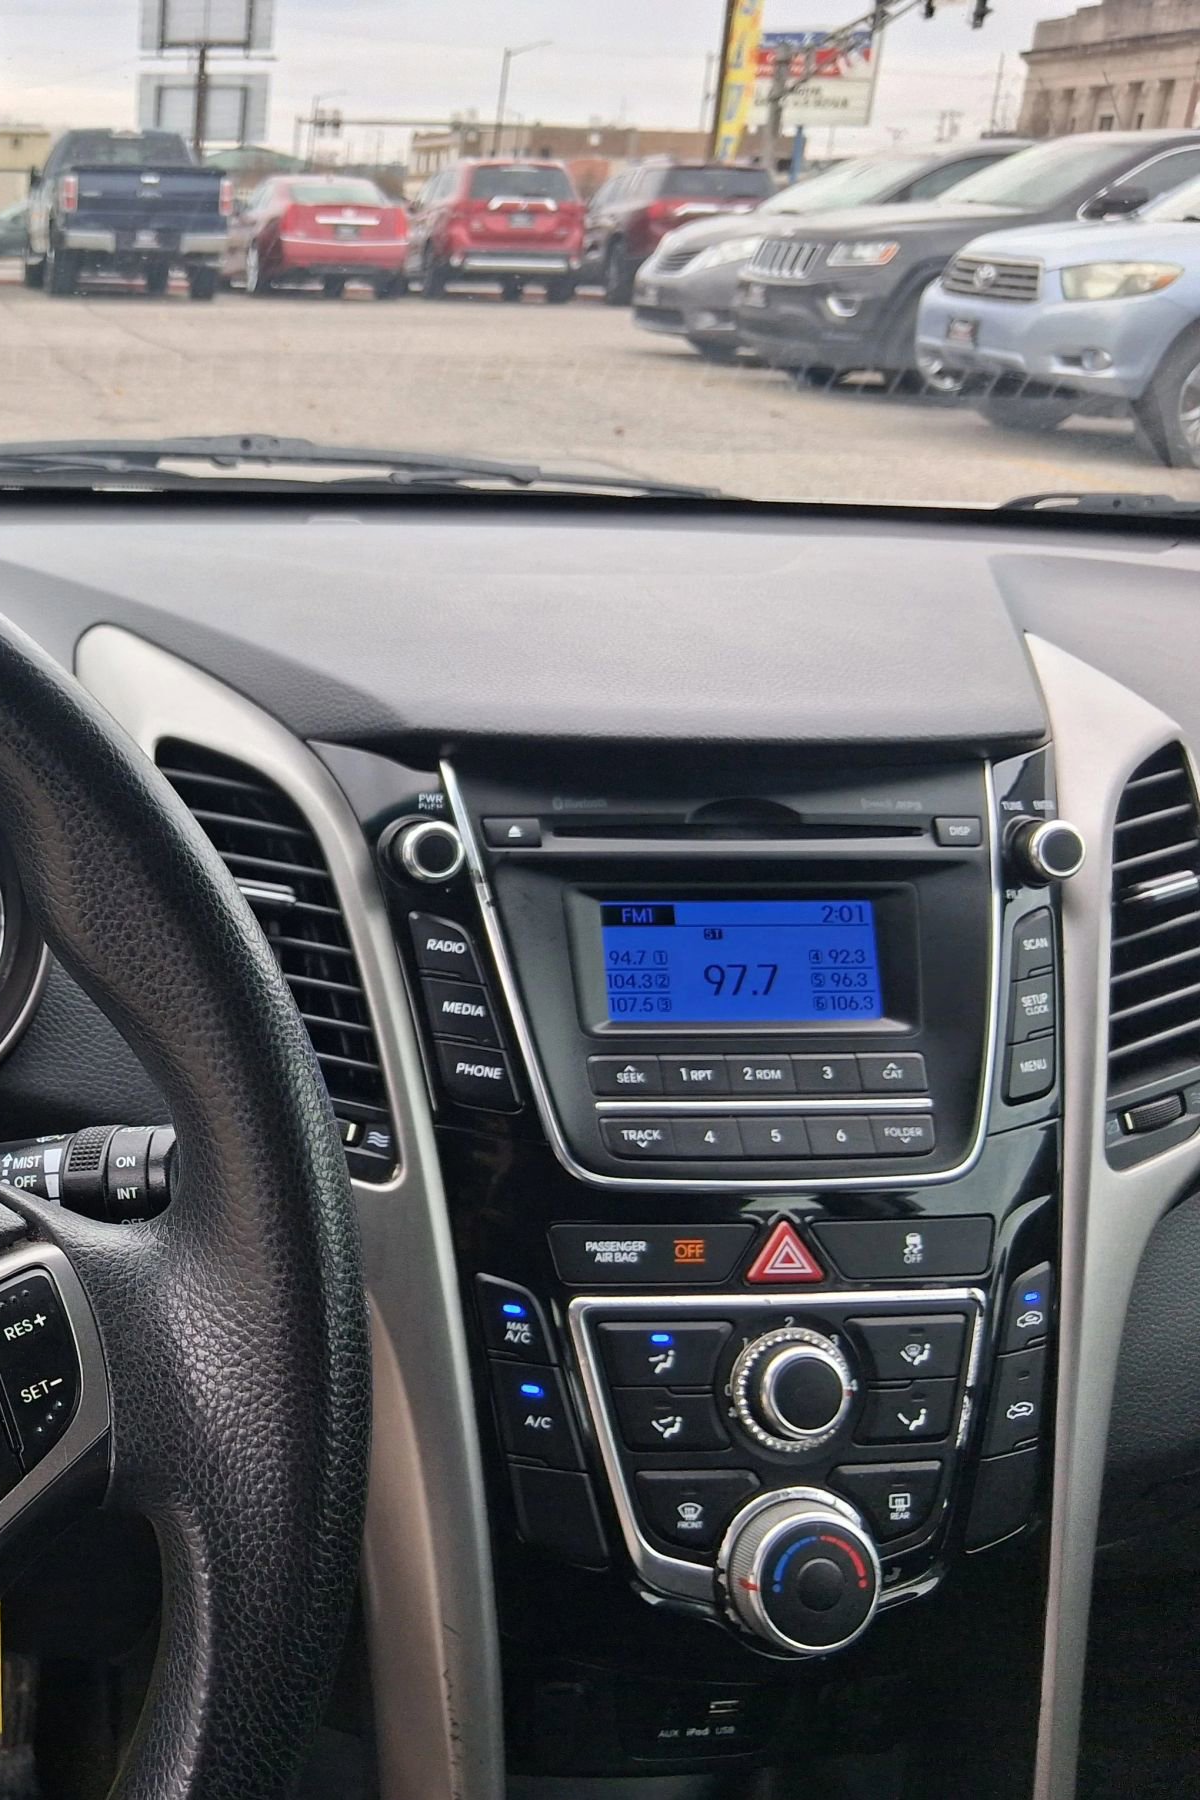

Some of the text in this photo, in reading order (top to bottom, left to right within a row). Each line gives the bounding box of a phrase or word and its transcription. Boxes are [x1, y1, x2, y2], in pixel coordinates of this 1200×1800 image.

[418, 794, 443, 804] PWR
[948, 826, 971, 837] DISP
[621, 908, 653, 923] FM1
[821, 905, 864, 923] 2:01
[704, 928, 722, 940] ST
[426, 938, 466, 955] RADIO
[1023, 938, 1048, 950] SCAN
[609, 951, 646, 965] 94.7
[828, 949, 866, 964] 92.3
[607, 974, 652, 989] 104.3
[703, 963, 778, 996] 97.7
[831, 973, 868, 988] 96.3
[610, 997, 654, 1012] 107.5
[831, 996, 874, 1011] 106.3
[1021, 993, 1048, 1007] SETUP
[442, 1001, 486, 1017] MEDIA
[1025, 1005, 1049, 1016] CLOCK
[456, 1062, 503, 1080] PHONE
[1020, 1059, 1047, 1073] MENU
[616, 1071, 645, 1084] SEEK
[680, 1068, 713, 1081] 1 RPT
[743, 1067, 782, 1081] 2 RDM
[822, 1066, 833, 1080] 3
[883, 1068, 903, 1079] CAT
[621, 1130, 662, 1141] TRACK
[704, 1130, 715, 1143] 4
[771, 1129, 782, 1143] 5
[836, 1128, 847, 1142] 6
[884, 1126, 923, 1138] FOLDER
[12, 1155, 42, 1169] MIST
[116, 1156, 136, 1168] ON
[14, 1175, 37, 1188] OFF
[117, 1186, 139, 1200] INT
[585, 1240, 646, 1252] PASSENGER
[675, 1244, 703, 1258] OFF
[595, 1251, 638, 1263] AIR BAG
[904, 1253, 923, 1264] OFF
[506, 1322, 530, 1331] MAX
[784, 1316, 795, 1327] 2
[504, 1331, 531, 1344] A/C
[830, 1334, 839, 1346] 3
[524, 1415, 553, 1429] A/C
[890, 1512, 910, 1520] REAR
[677, 1521, 703, 1529] FRONT
[658, 1729, 679, 1738] AUX
